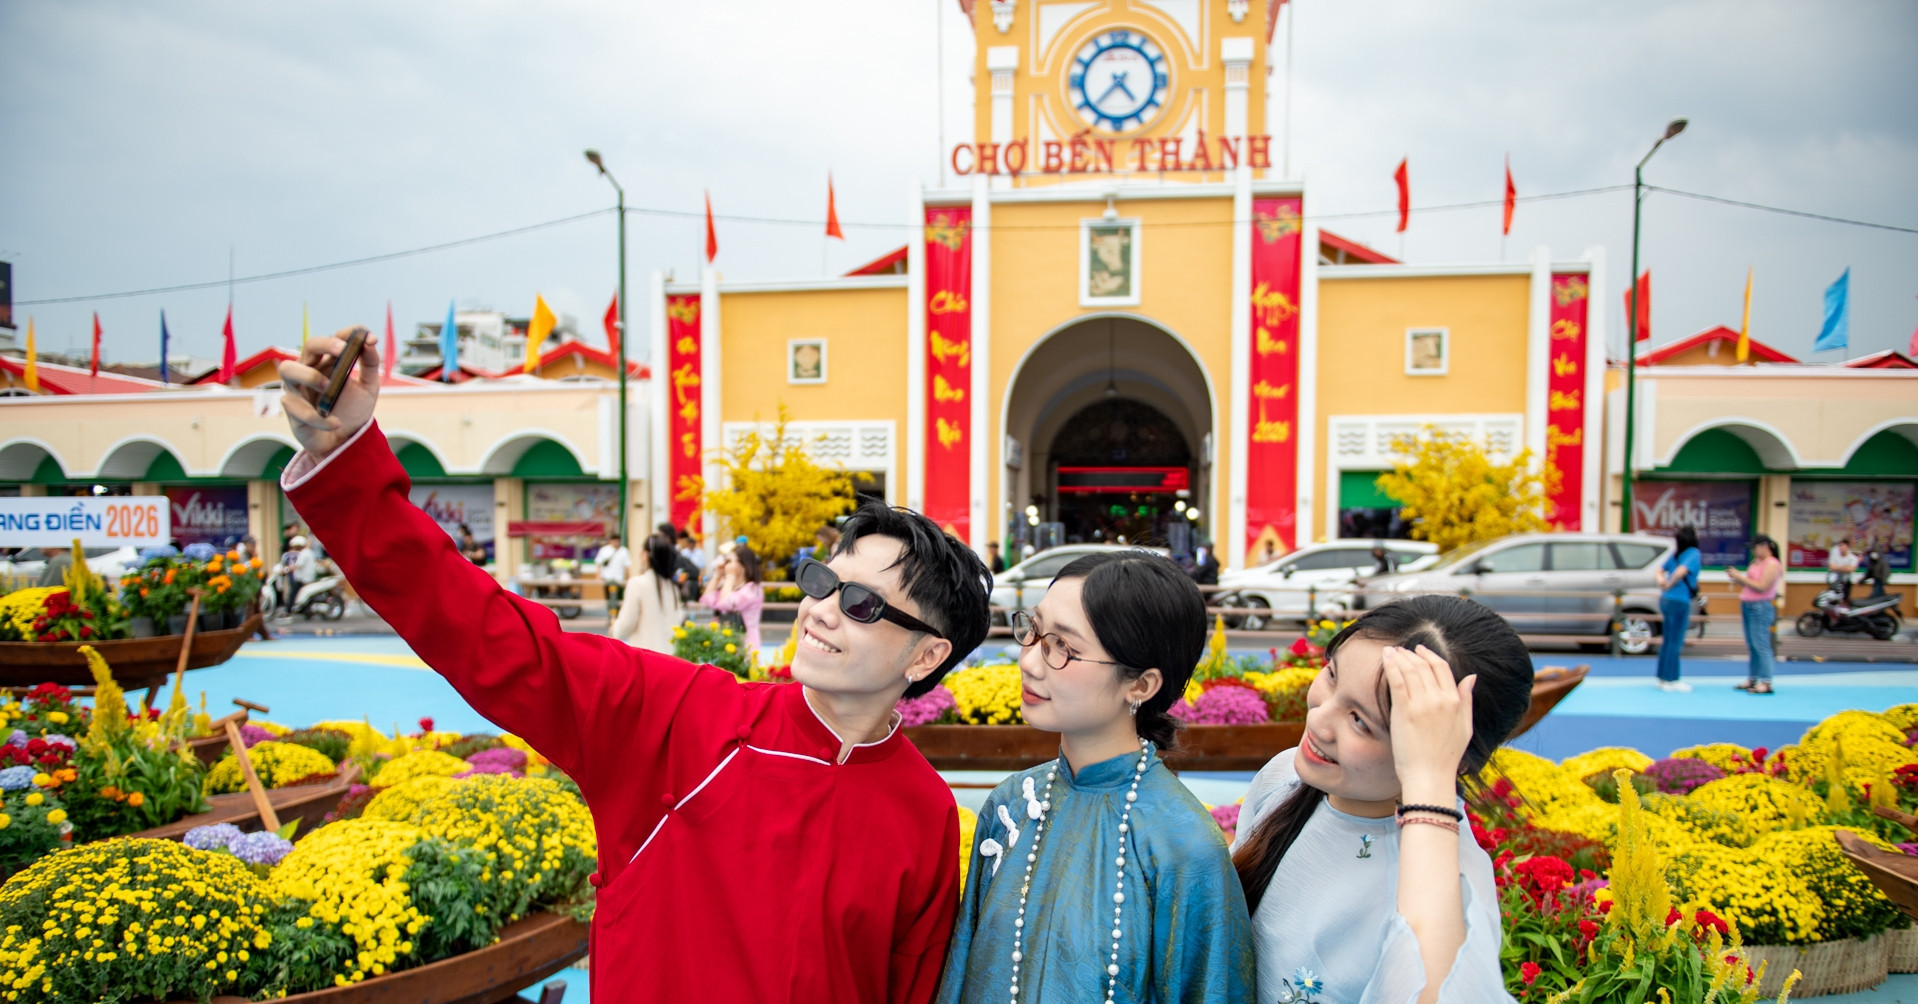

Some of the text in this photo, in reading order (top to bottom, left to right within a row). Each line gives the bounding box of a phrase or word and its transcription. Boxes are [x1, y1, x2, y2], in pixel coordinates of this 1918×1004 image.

[951, 128, 1272, 178] CHỢ BẾN THÀNH
[44, 502, 101, 530] ĐIỀN
[106, 504, 159, 538] 2026
[172, 492, 225, 527] Vikki
[1635, 487, 1707, 529] Vikki
